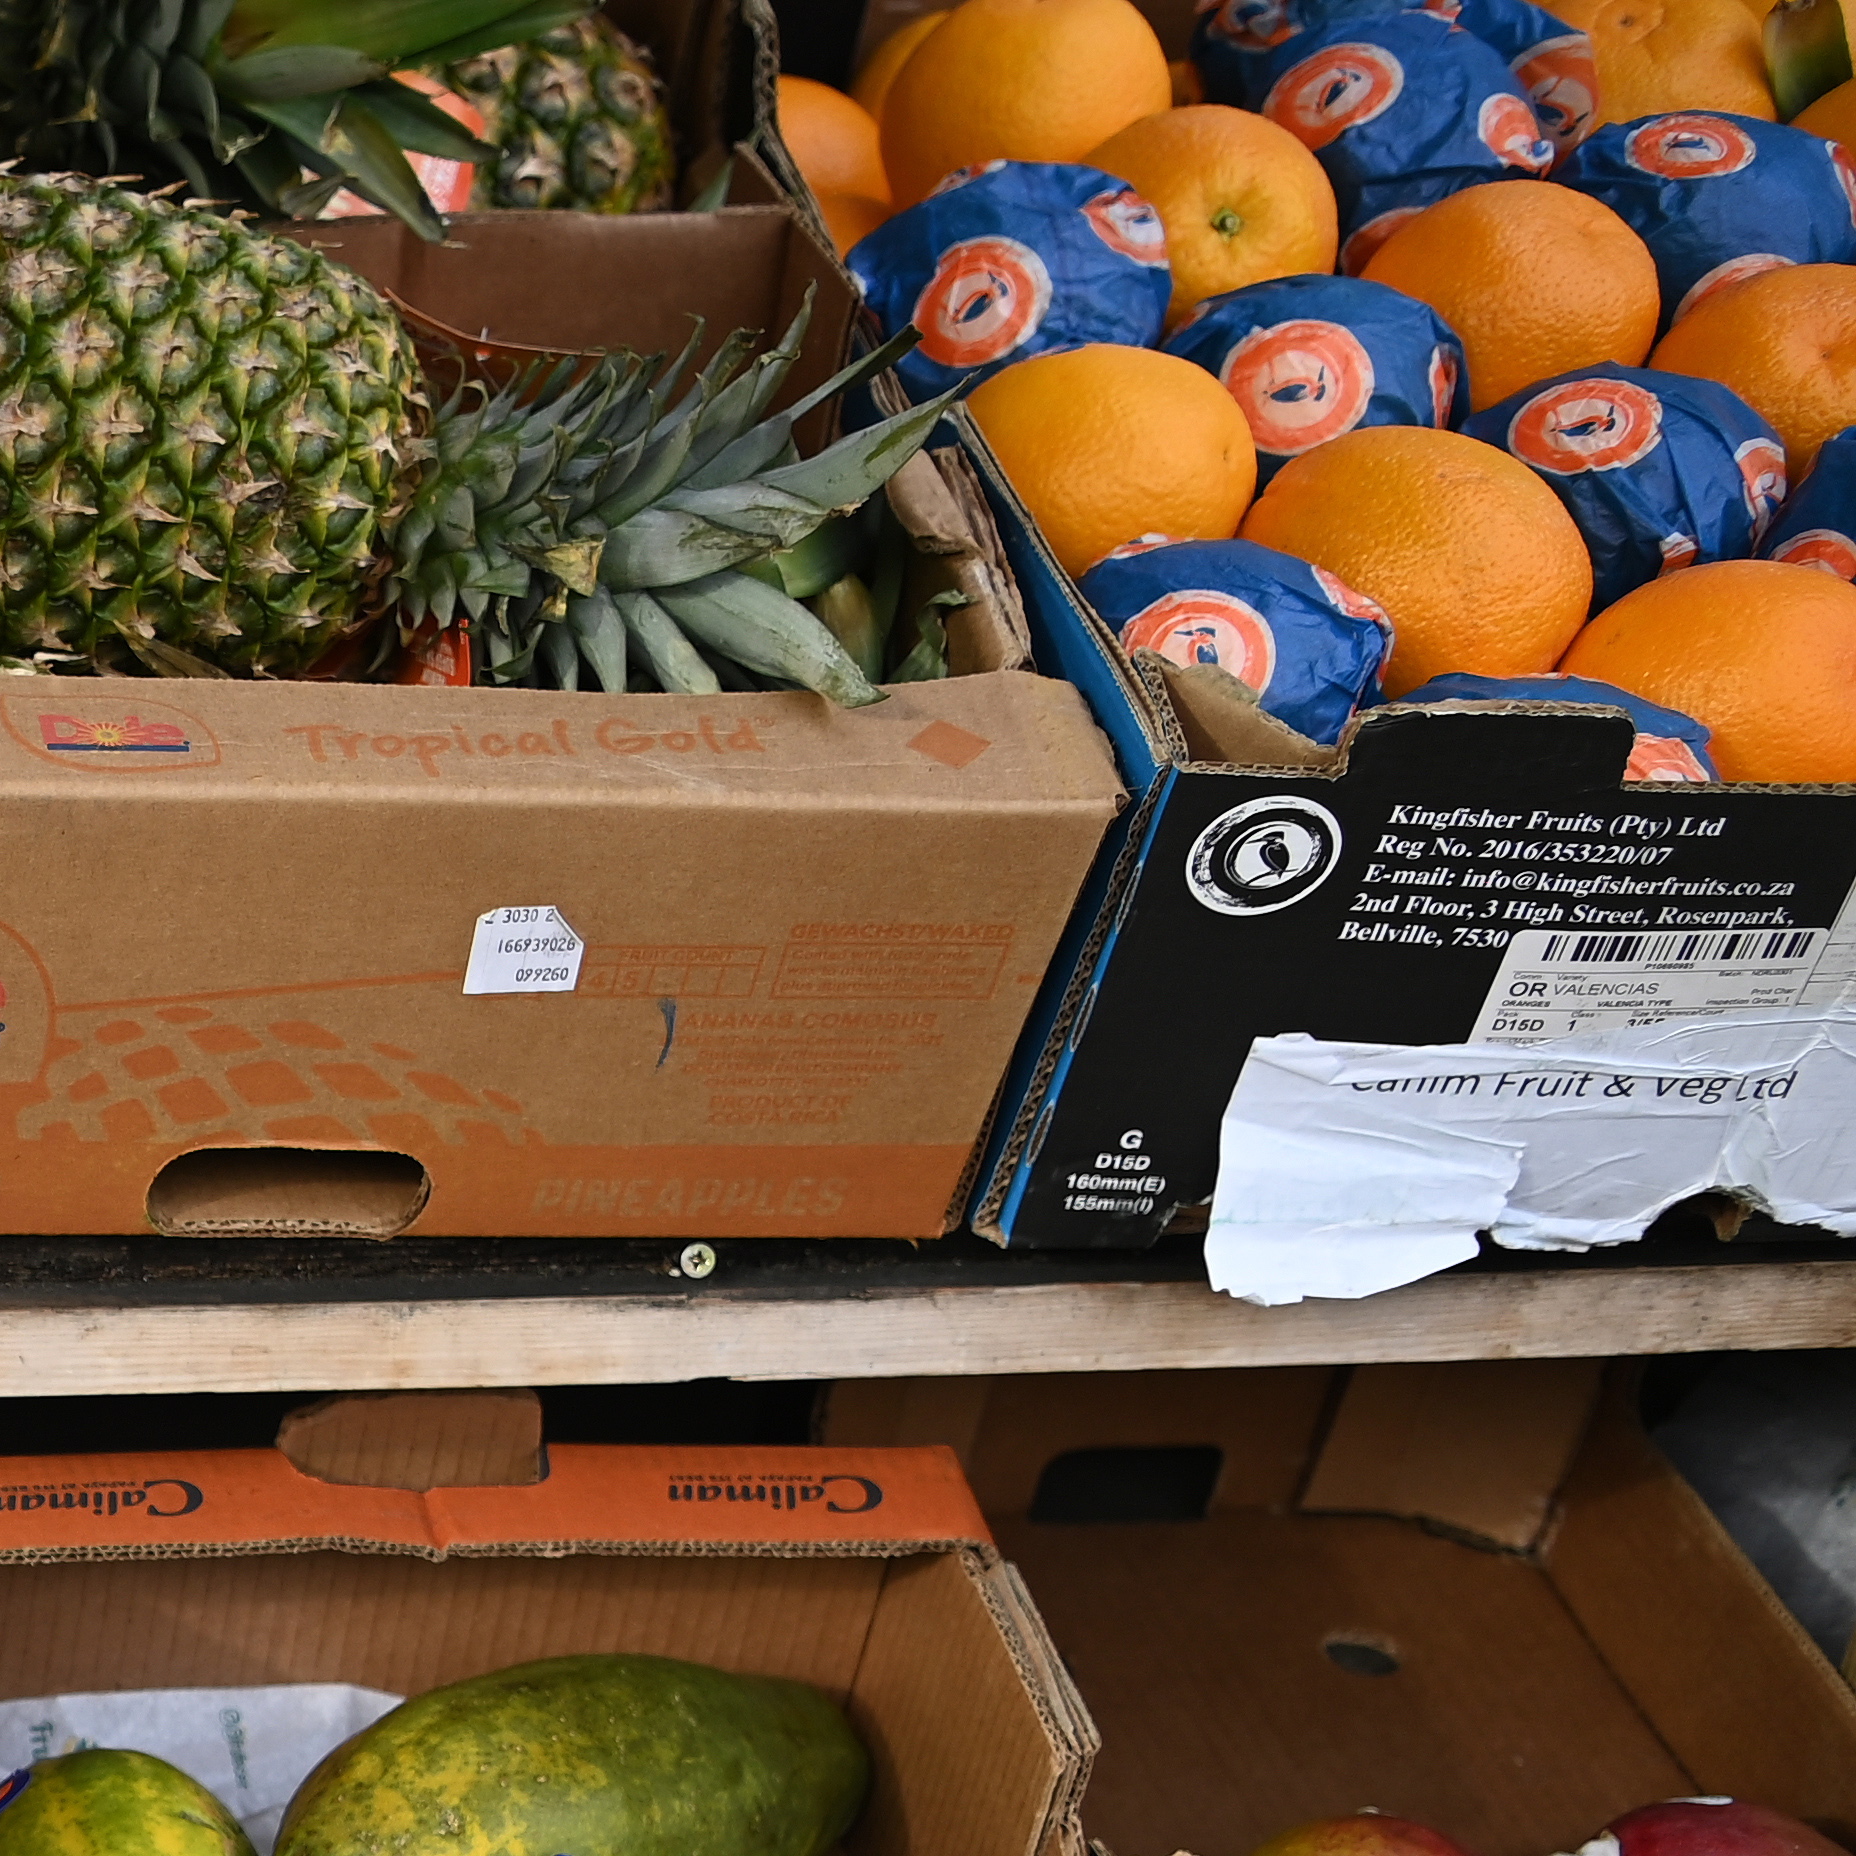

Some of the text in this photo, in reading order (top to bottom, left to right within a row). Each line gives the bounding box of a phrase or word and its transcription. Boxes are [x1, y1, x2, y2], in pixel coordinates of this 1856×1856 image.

[37, 714, 188, 747] Dole
[285, 719, 572, 777] Tropical
[1387, 805, 1726, 839] Kingfisher Fruits (Pty) Ltd
[1374, 835, 1673, 865] Reg No. 2016/353220/07
[1362, 865, 1795, 898] E-mail: info@kingfisherfruits.co.za
[502, 908, 539, 924] 3030
[1349, 894, 1794, 931] 2nd Floor, 3 High Street, Rosenpark,
[1337, 922, 1509, 948] Bellville, 7530
[516, 967, 569, 982] 099260
[1509, 982, 1660, 997] OR VALENCIAS
[1492, 1019, 1545, 1032] D15D
[1493, 1071, 1591, 1098] Fruit
[1603, 1075, 1635, 1098] &
[1656, 1076, 1732, 1104] Veg
[1119, 1129, 1144, 1150] G
[1094, 1152, 1151, 1170] D15D
[533, 1177, 848, 1217] PINEAPPLES
[1066, 1173, 1166, 1195] 160mm(E)
[668, 1474, 883, 1514] Caliman
